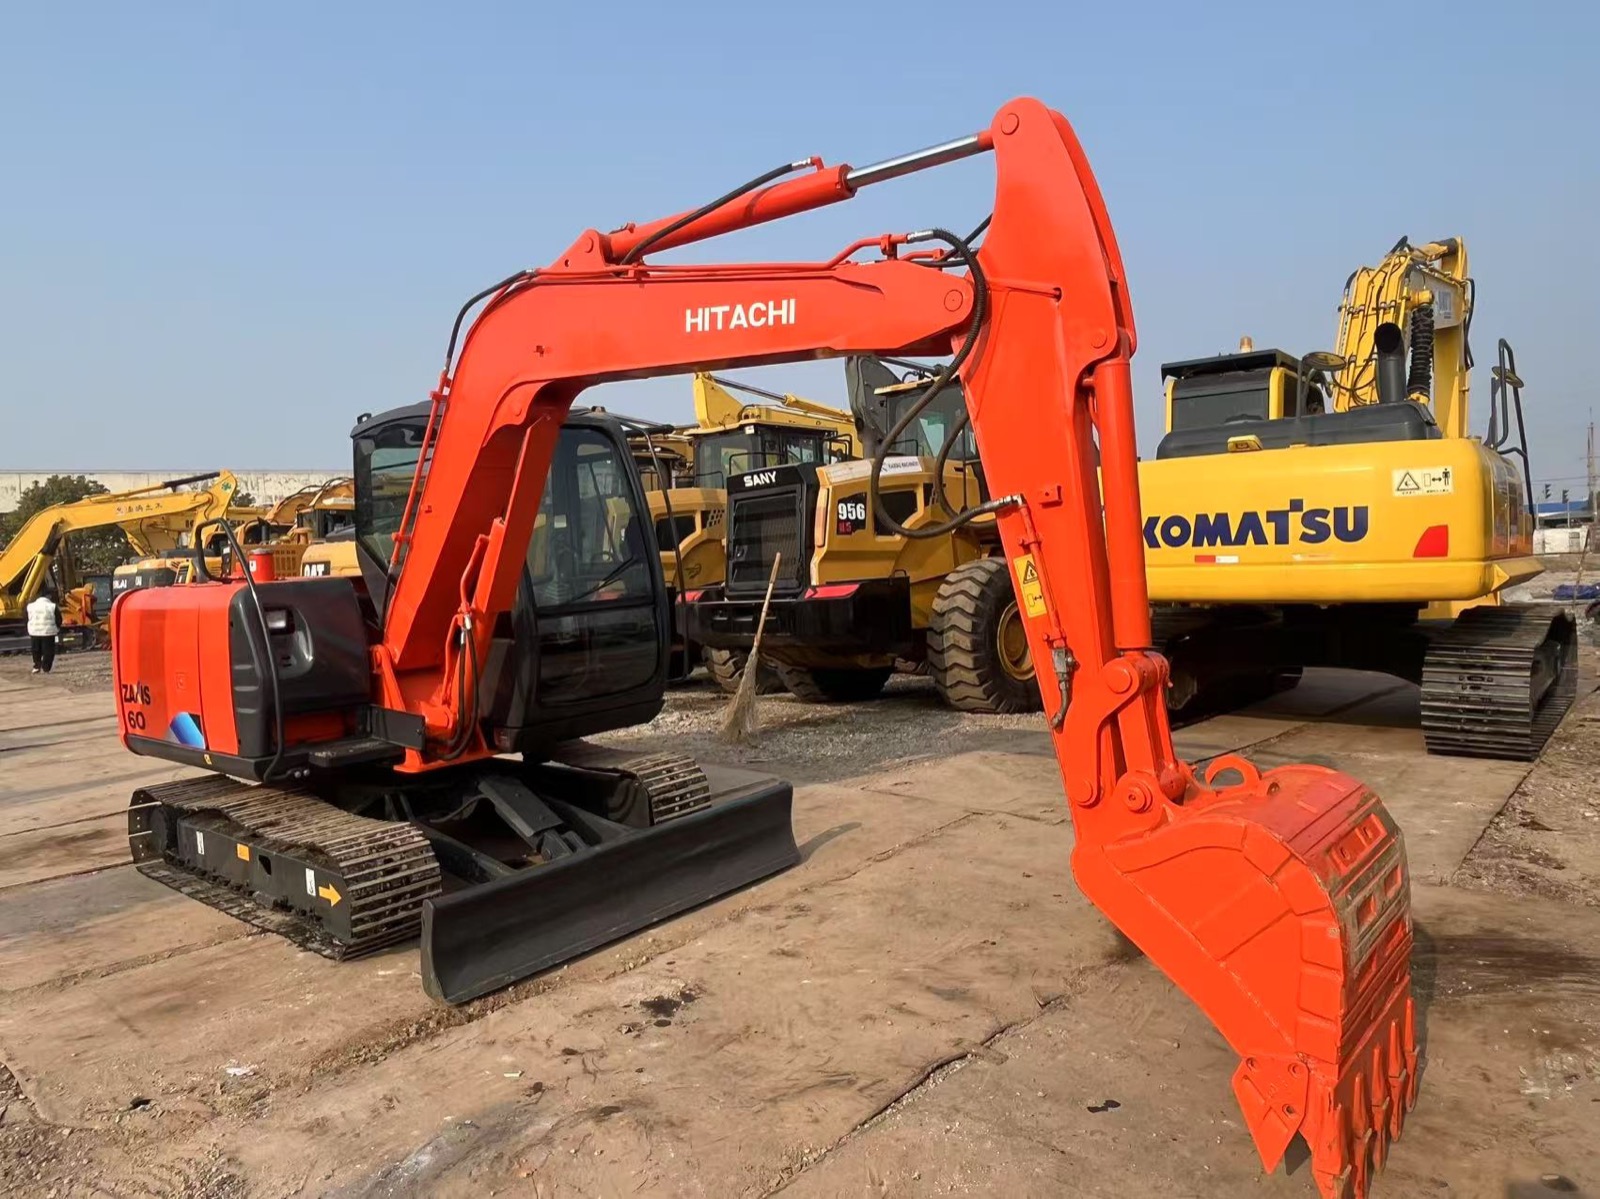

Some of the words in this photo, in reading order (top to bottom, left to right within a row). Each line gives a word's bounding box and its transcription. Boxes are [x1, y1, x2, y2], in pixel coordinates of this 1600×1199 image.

[685, 297, 796, 333] HITACHI
[743, 470, 777, 488] SANY
[838, 502, 866, 520] 956
[1143, 499, 1369, 549] KOMATSU
[128, 711, 146, 730] 60
